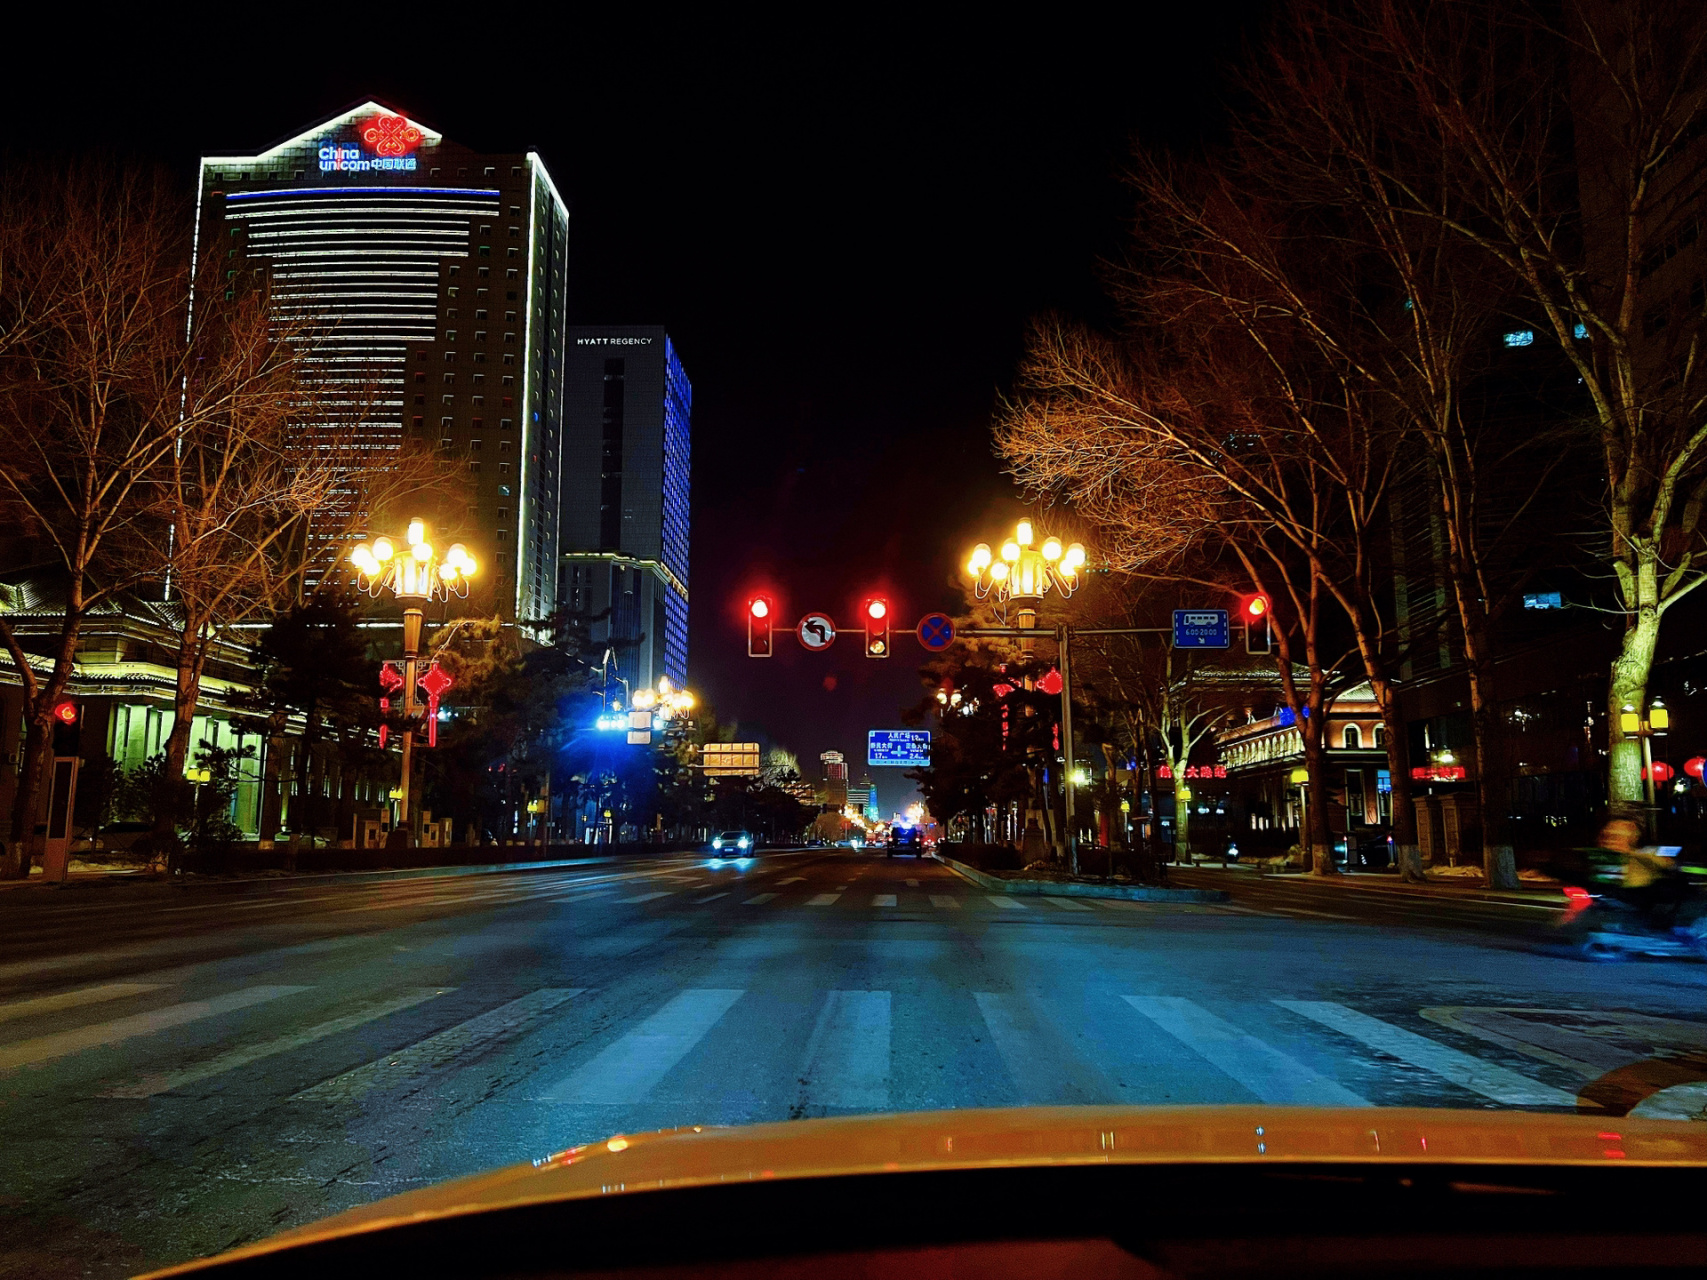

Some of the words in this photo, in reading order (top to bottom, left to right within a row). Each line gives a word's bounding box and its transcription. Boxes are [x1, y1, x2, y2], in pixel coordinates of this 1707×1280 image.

[318, 146, 360, 160] China
[319, 159, 371, 171] unicom
[371, 158, 417, 171] 中国联通
